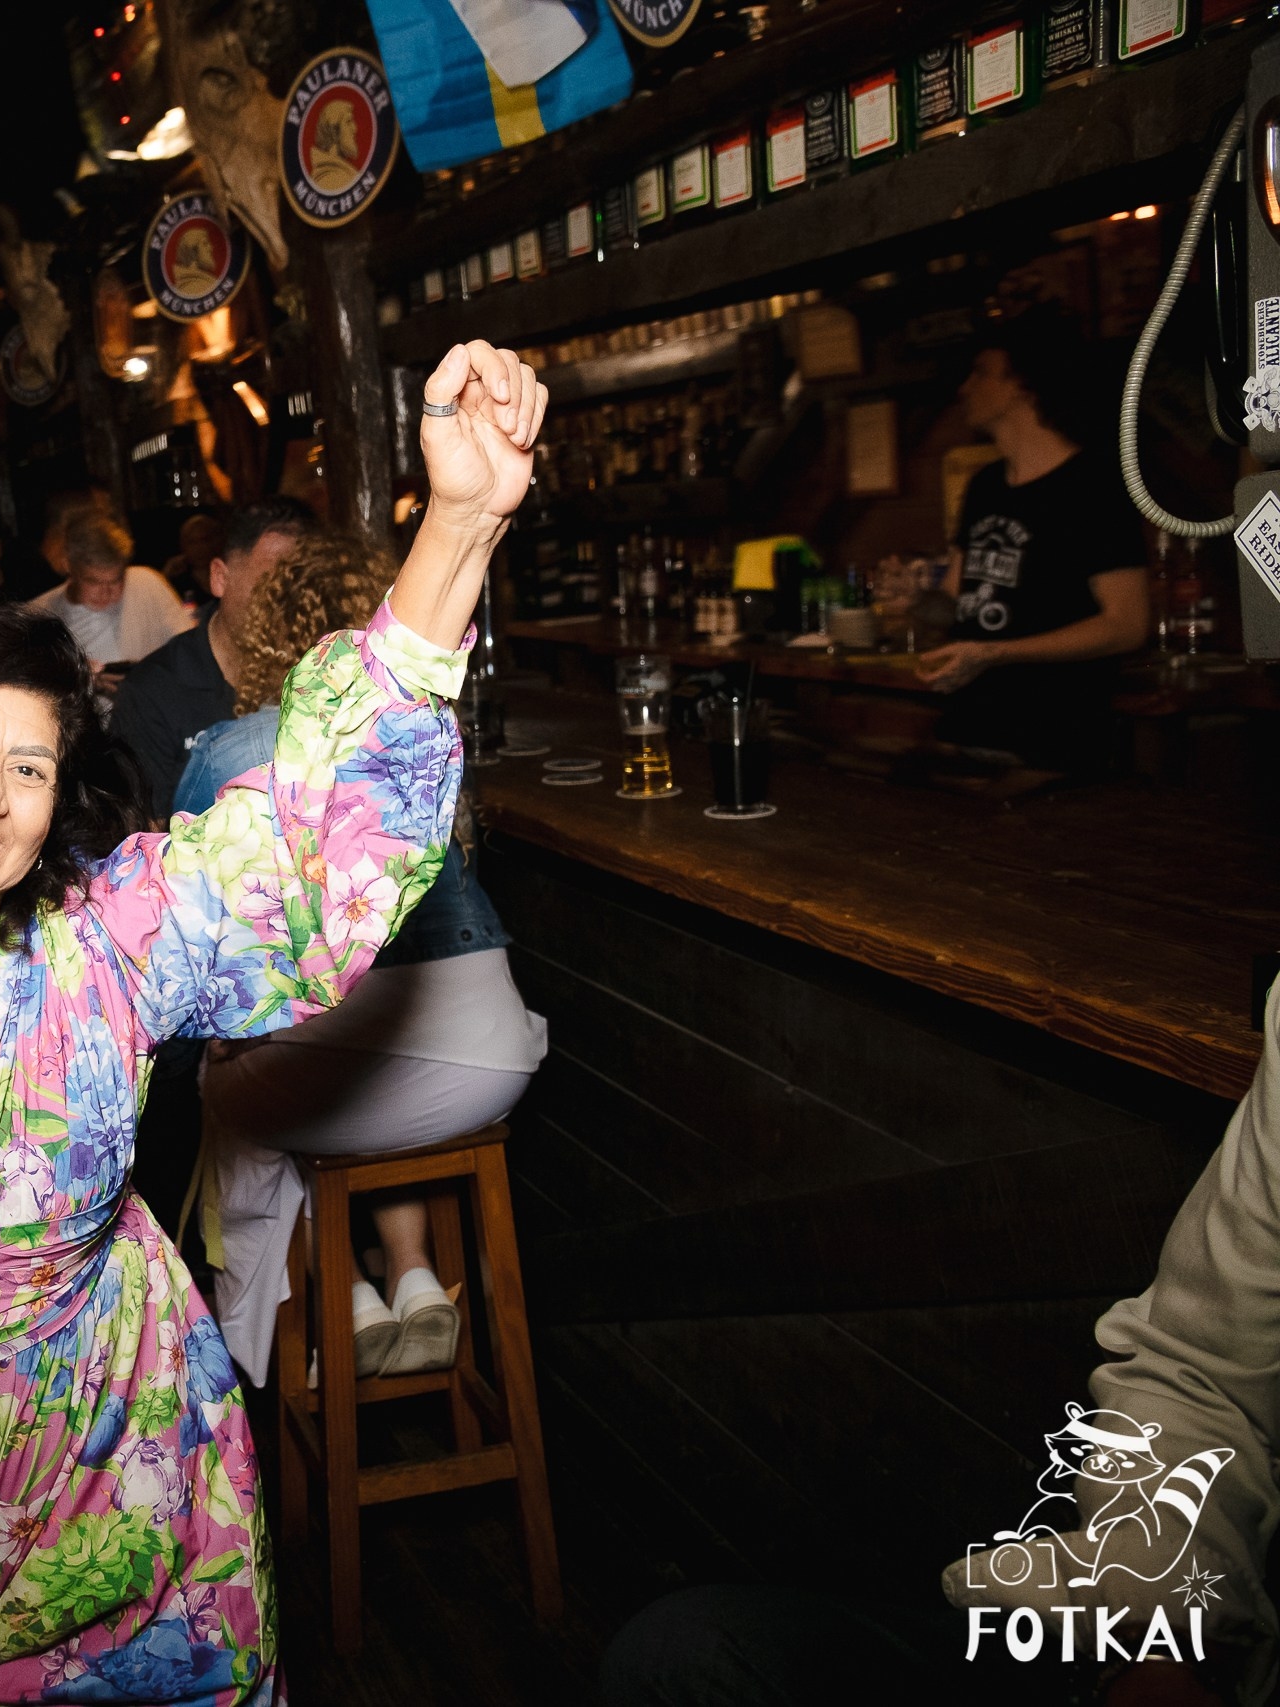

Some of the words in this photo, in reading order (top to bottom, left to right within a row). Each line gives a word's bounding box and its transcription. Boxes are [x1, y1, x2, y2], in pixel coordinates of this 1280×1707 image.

[286, 57, 390, 126] PAULANER
[293, 170, 377, 217] MÜNCHEN
[1257, 301, 1265, 370] STONEBIKERS
[1265, 298, 1280, 366] ALICANTE
